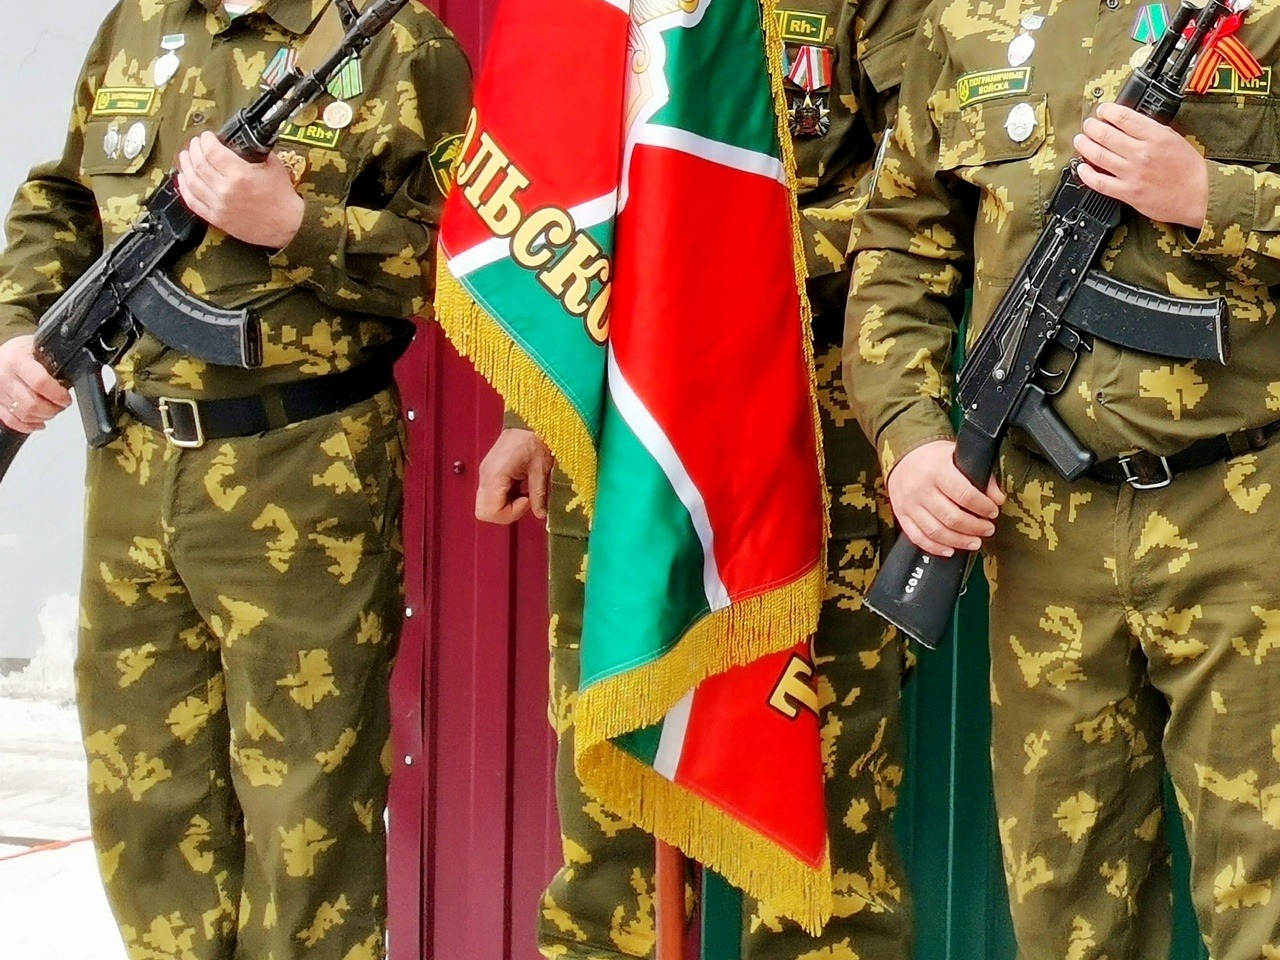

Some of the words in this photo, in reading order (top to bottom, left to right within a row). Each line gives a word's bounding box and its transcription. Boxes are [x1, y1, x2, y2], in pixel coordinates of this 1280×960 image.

[790, 19, 817, 34] Rh-
[969, 71, 1025, 87] ПОГРАНИЧНЫЕ
[978, 82, 1009, 95] ВОЙСКА
